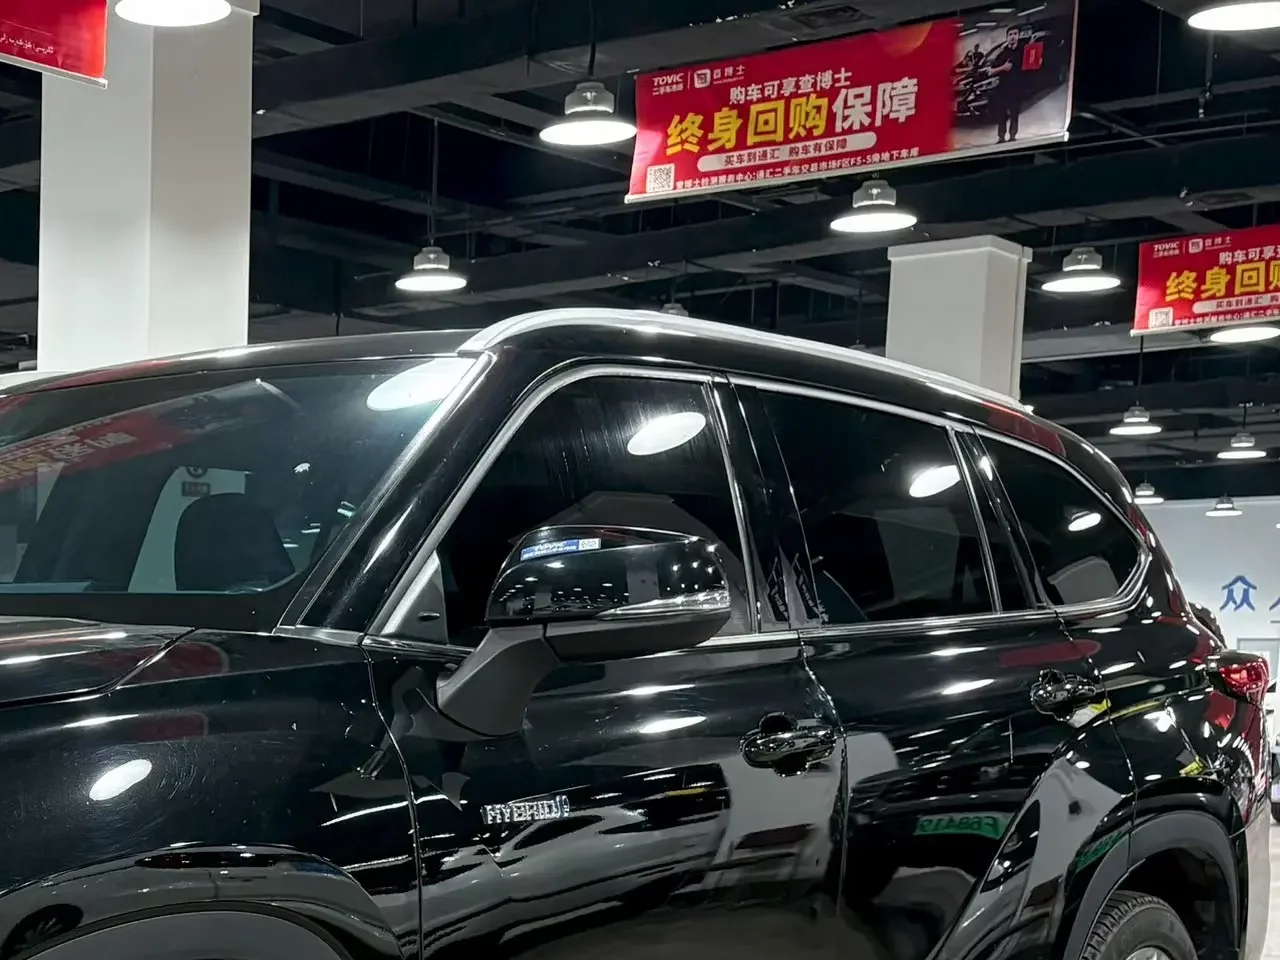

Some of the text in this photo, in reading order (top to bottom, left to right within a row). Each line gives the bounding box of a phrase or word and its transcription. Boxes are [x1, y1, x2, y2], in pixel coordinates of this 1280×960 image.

[652, 72, 683, 86] TOVIC
[729, 67, 853, 105] 购车可享查博士
[665, 77, 919, 155] 终身回购保障
[723, 137, 848, 167] 买车到通汇 购车有保障
[484, 800, 559, 824] HYBRID
